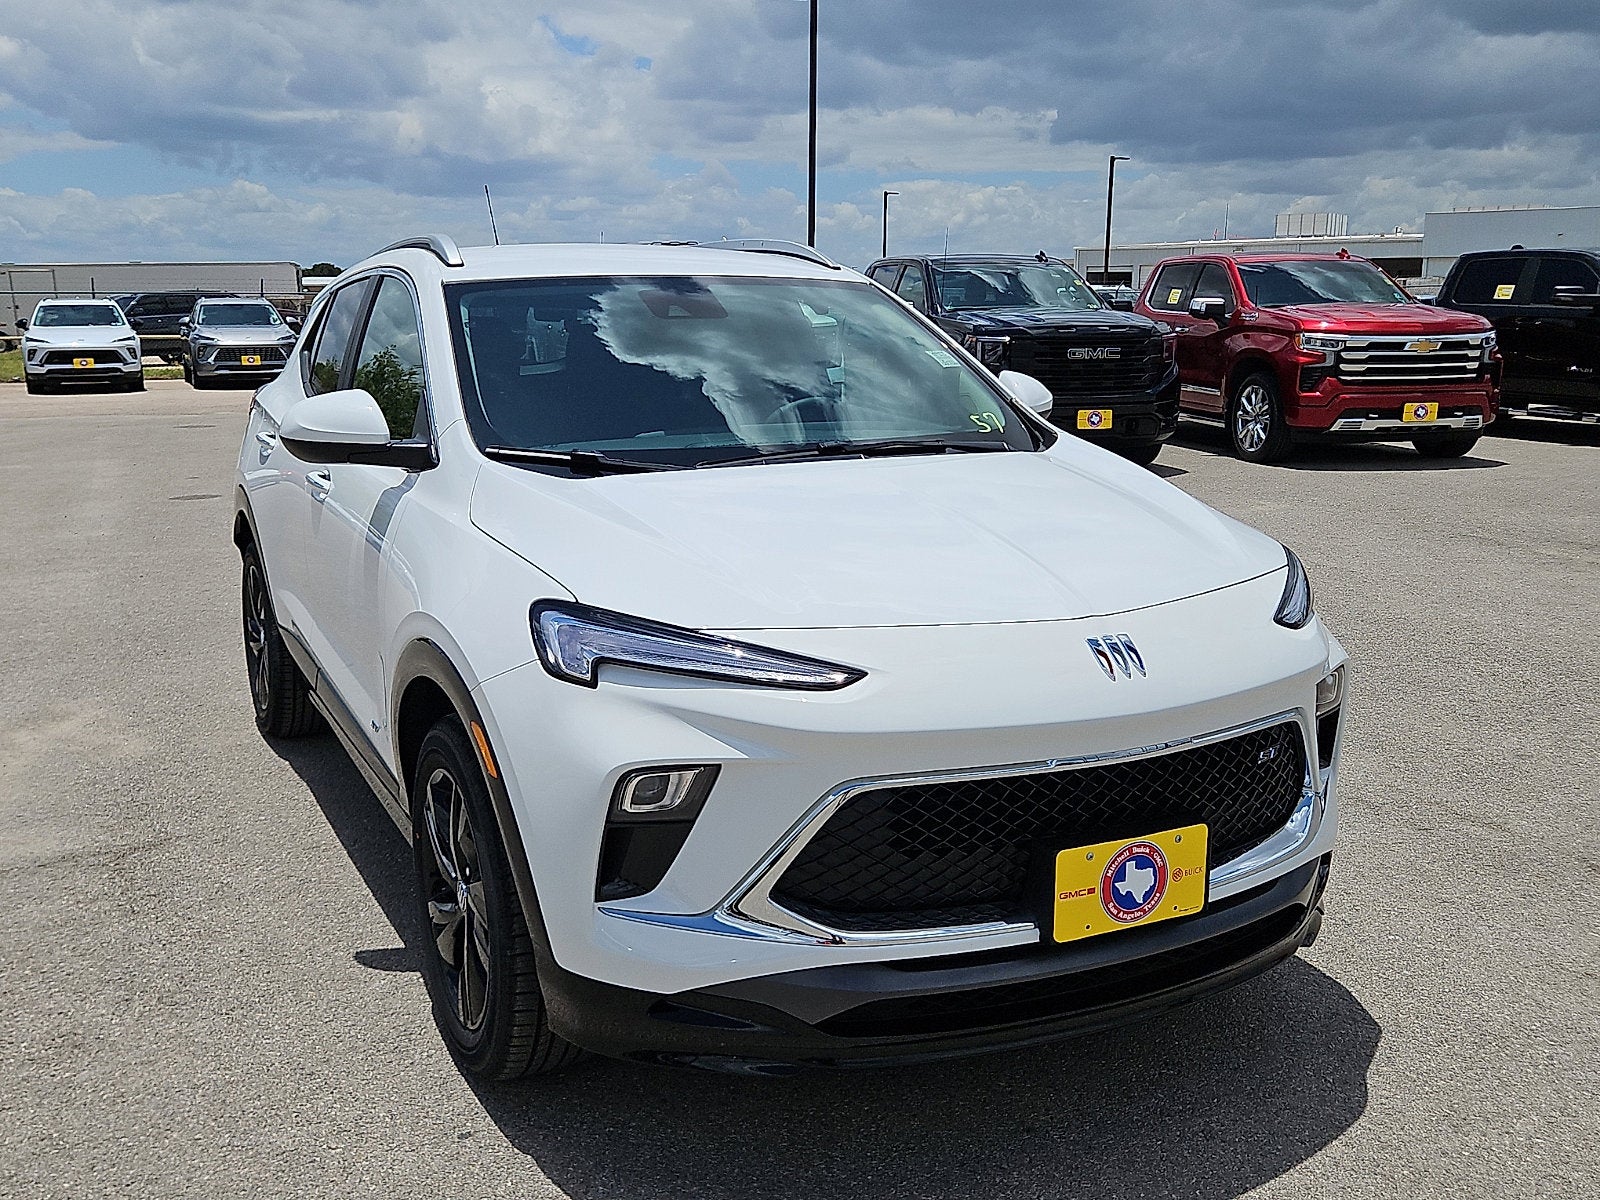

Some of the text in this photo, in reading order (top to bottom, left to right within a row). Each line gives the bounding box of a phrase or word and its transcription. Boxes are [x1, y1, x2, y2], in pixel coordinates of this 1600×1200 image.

[1067, 347, 1121, 360] GMC
[969, 411, 1005, 434] 57
[1106, 845, 1164, 878] Mitchell Buick GMC
[1184, 866, 1204, 877] BUICK
[1059, 888, 1087, 900] GMC
[1107, 901, 1118, 915] San
[1143, 892, 1161, 912] Texas
